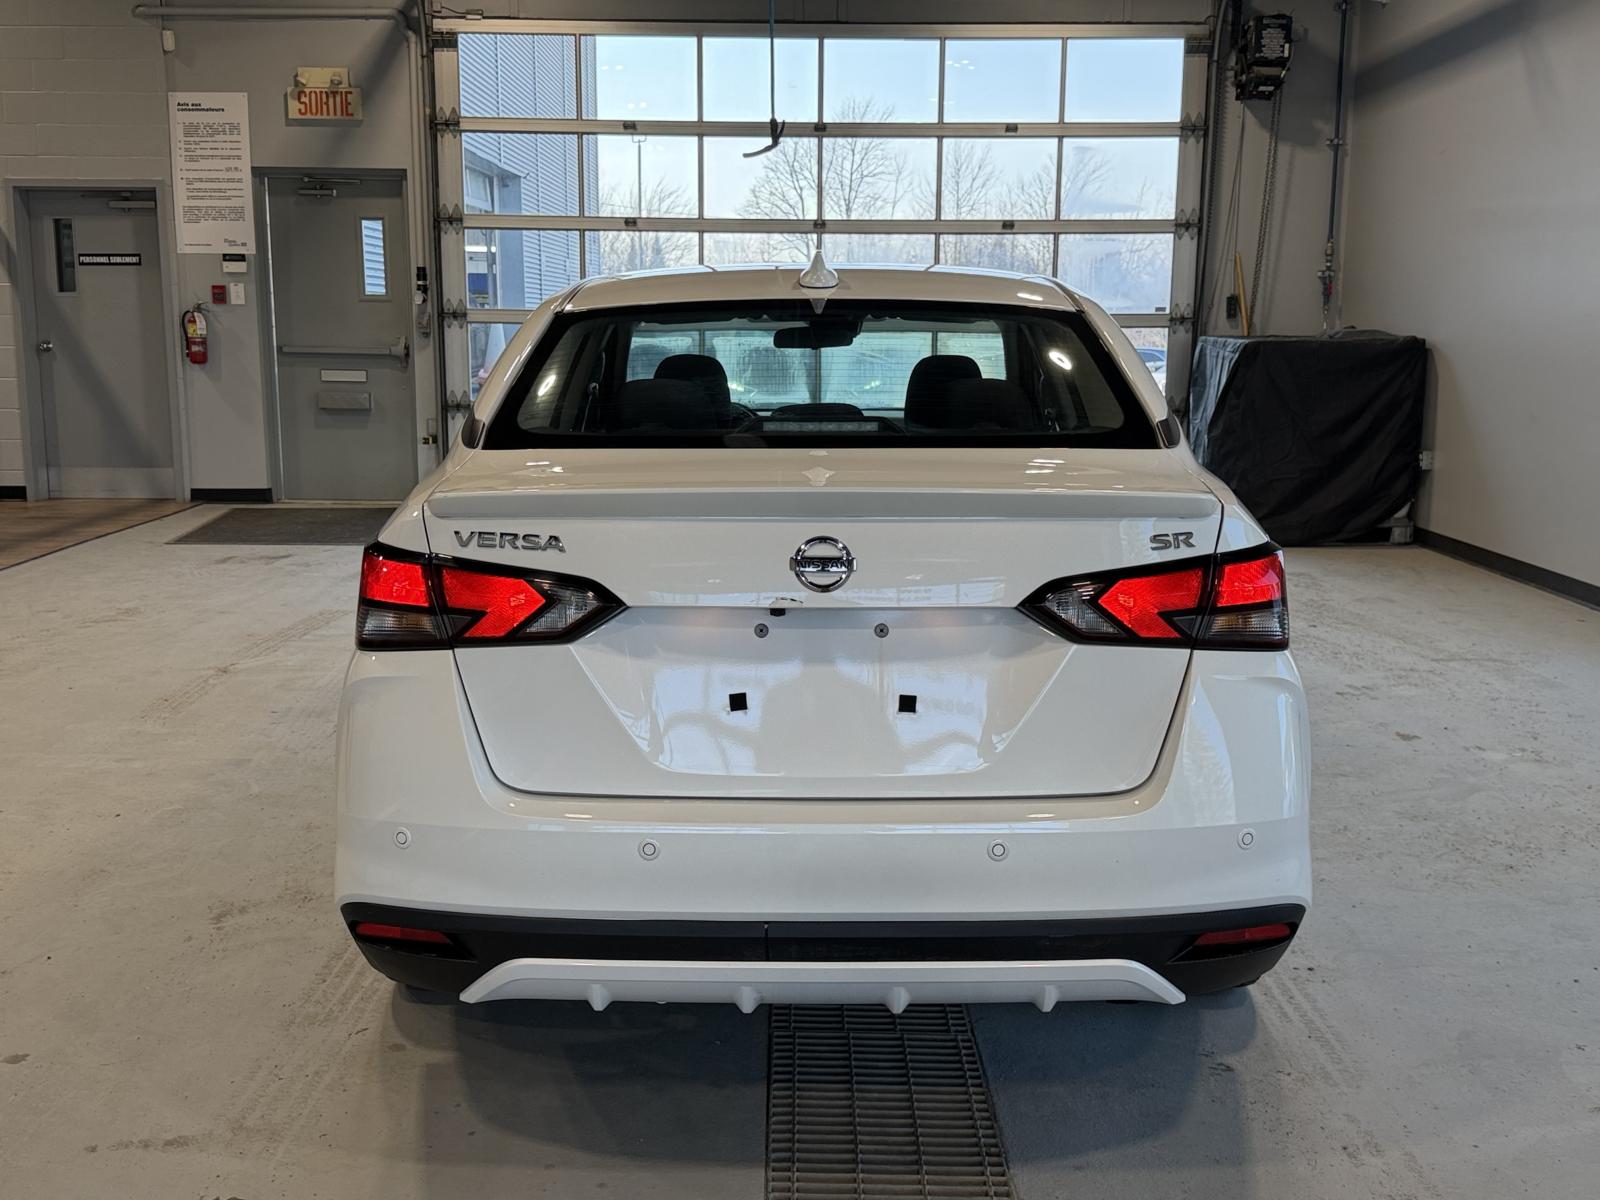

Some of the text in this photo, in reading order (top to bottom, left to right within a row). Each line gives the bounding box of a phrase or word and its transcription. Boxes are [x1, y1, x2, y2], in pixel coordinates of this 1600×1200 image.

[297, 90, 354, 117] SORTIE
[453, 529, 566, 553] VERSA
[1149, 531, 1196, 551] SR
[796, 560, 849, 570] NISSAN
